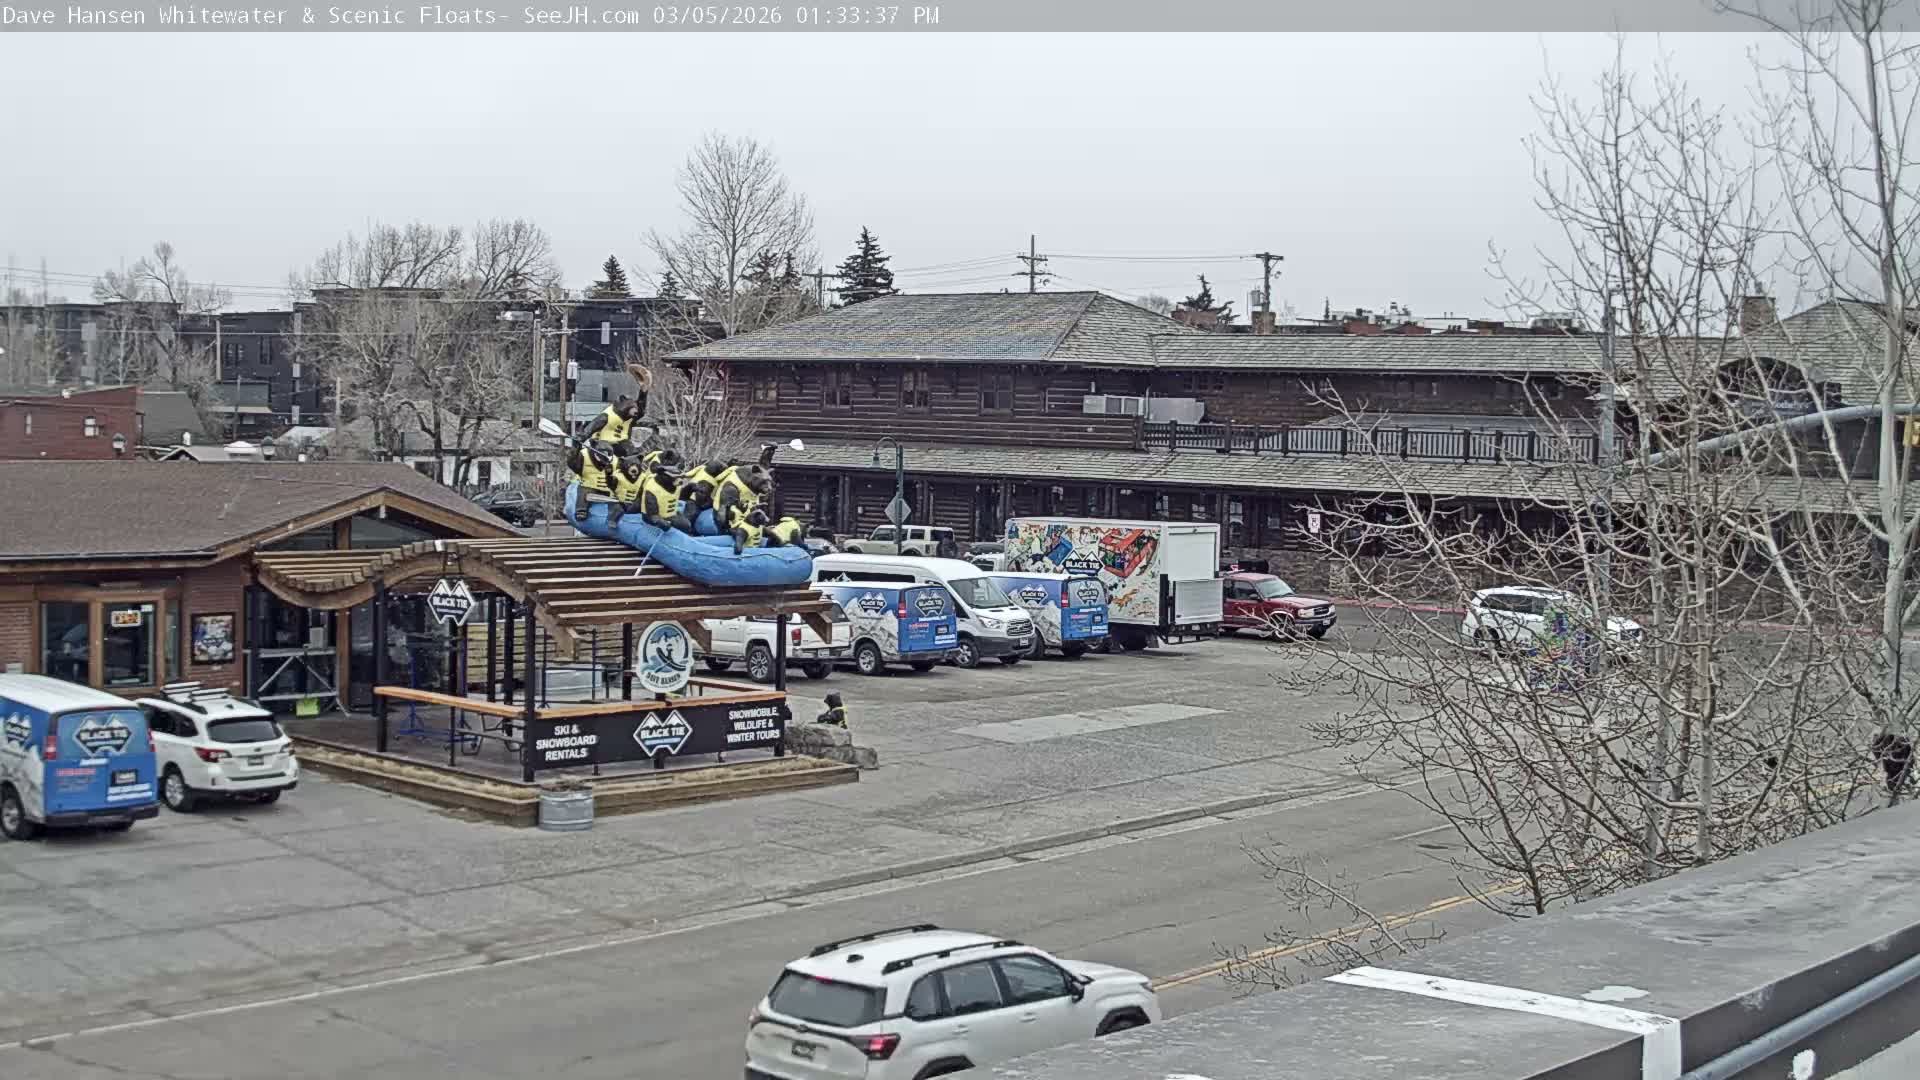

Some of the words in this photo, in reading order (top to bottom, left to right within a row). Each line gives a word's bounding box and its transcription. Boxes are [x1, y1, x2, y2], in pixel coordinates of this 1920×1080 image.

[1065, 560, 1087, 568] BLACK
[432, 596, 455, 607] BLACK
[554, 724, 570, 735] SKI
[571, 723, 580, 734] &
[734, 719, 766, 730] WILDLIFE
[768, 720, 774, 728] &
[640, 727, 670, 739] BLACK
[671, 726, 685, 736] TIE
[727, 732, 755, 743] WINTER
[756, 729, 780, 741] TOURS
[536, 734, 597, 750] SNOWBOARD
[545, 747, 588, 761] RENTALS
